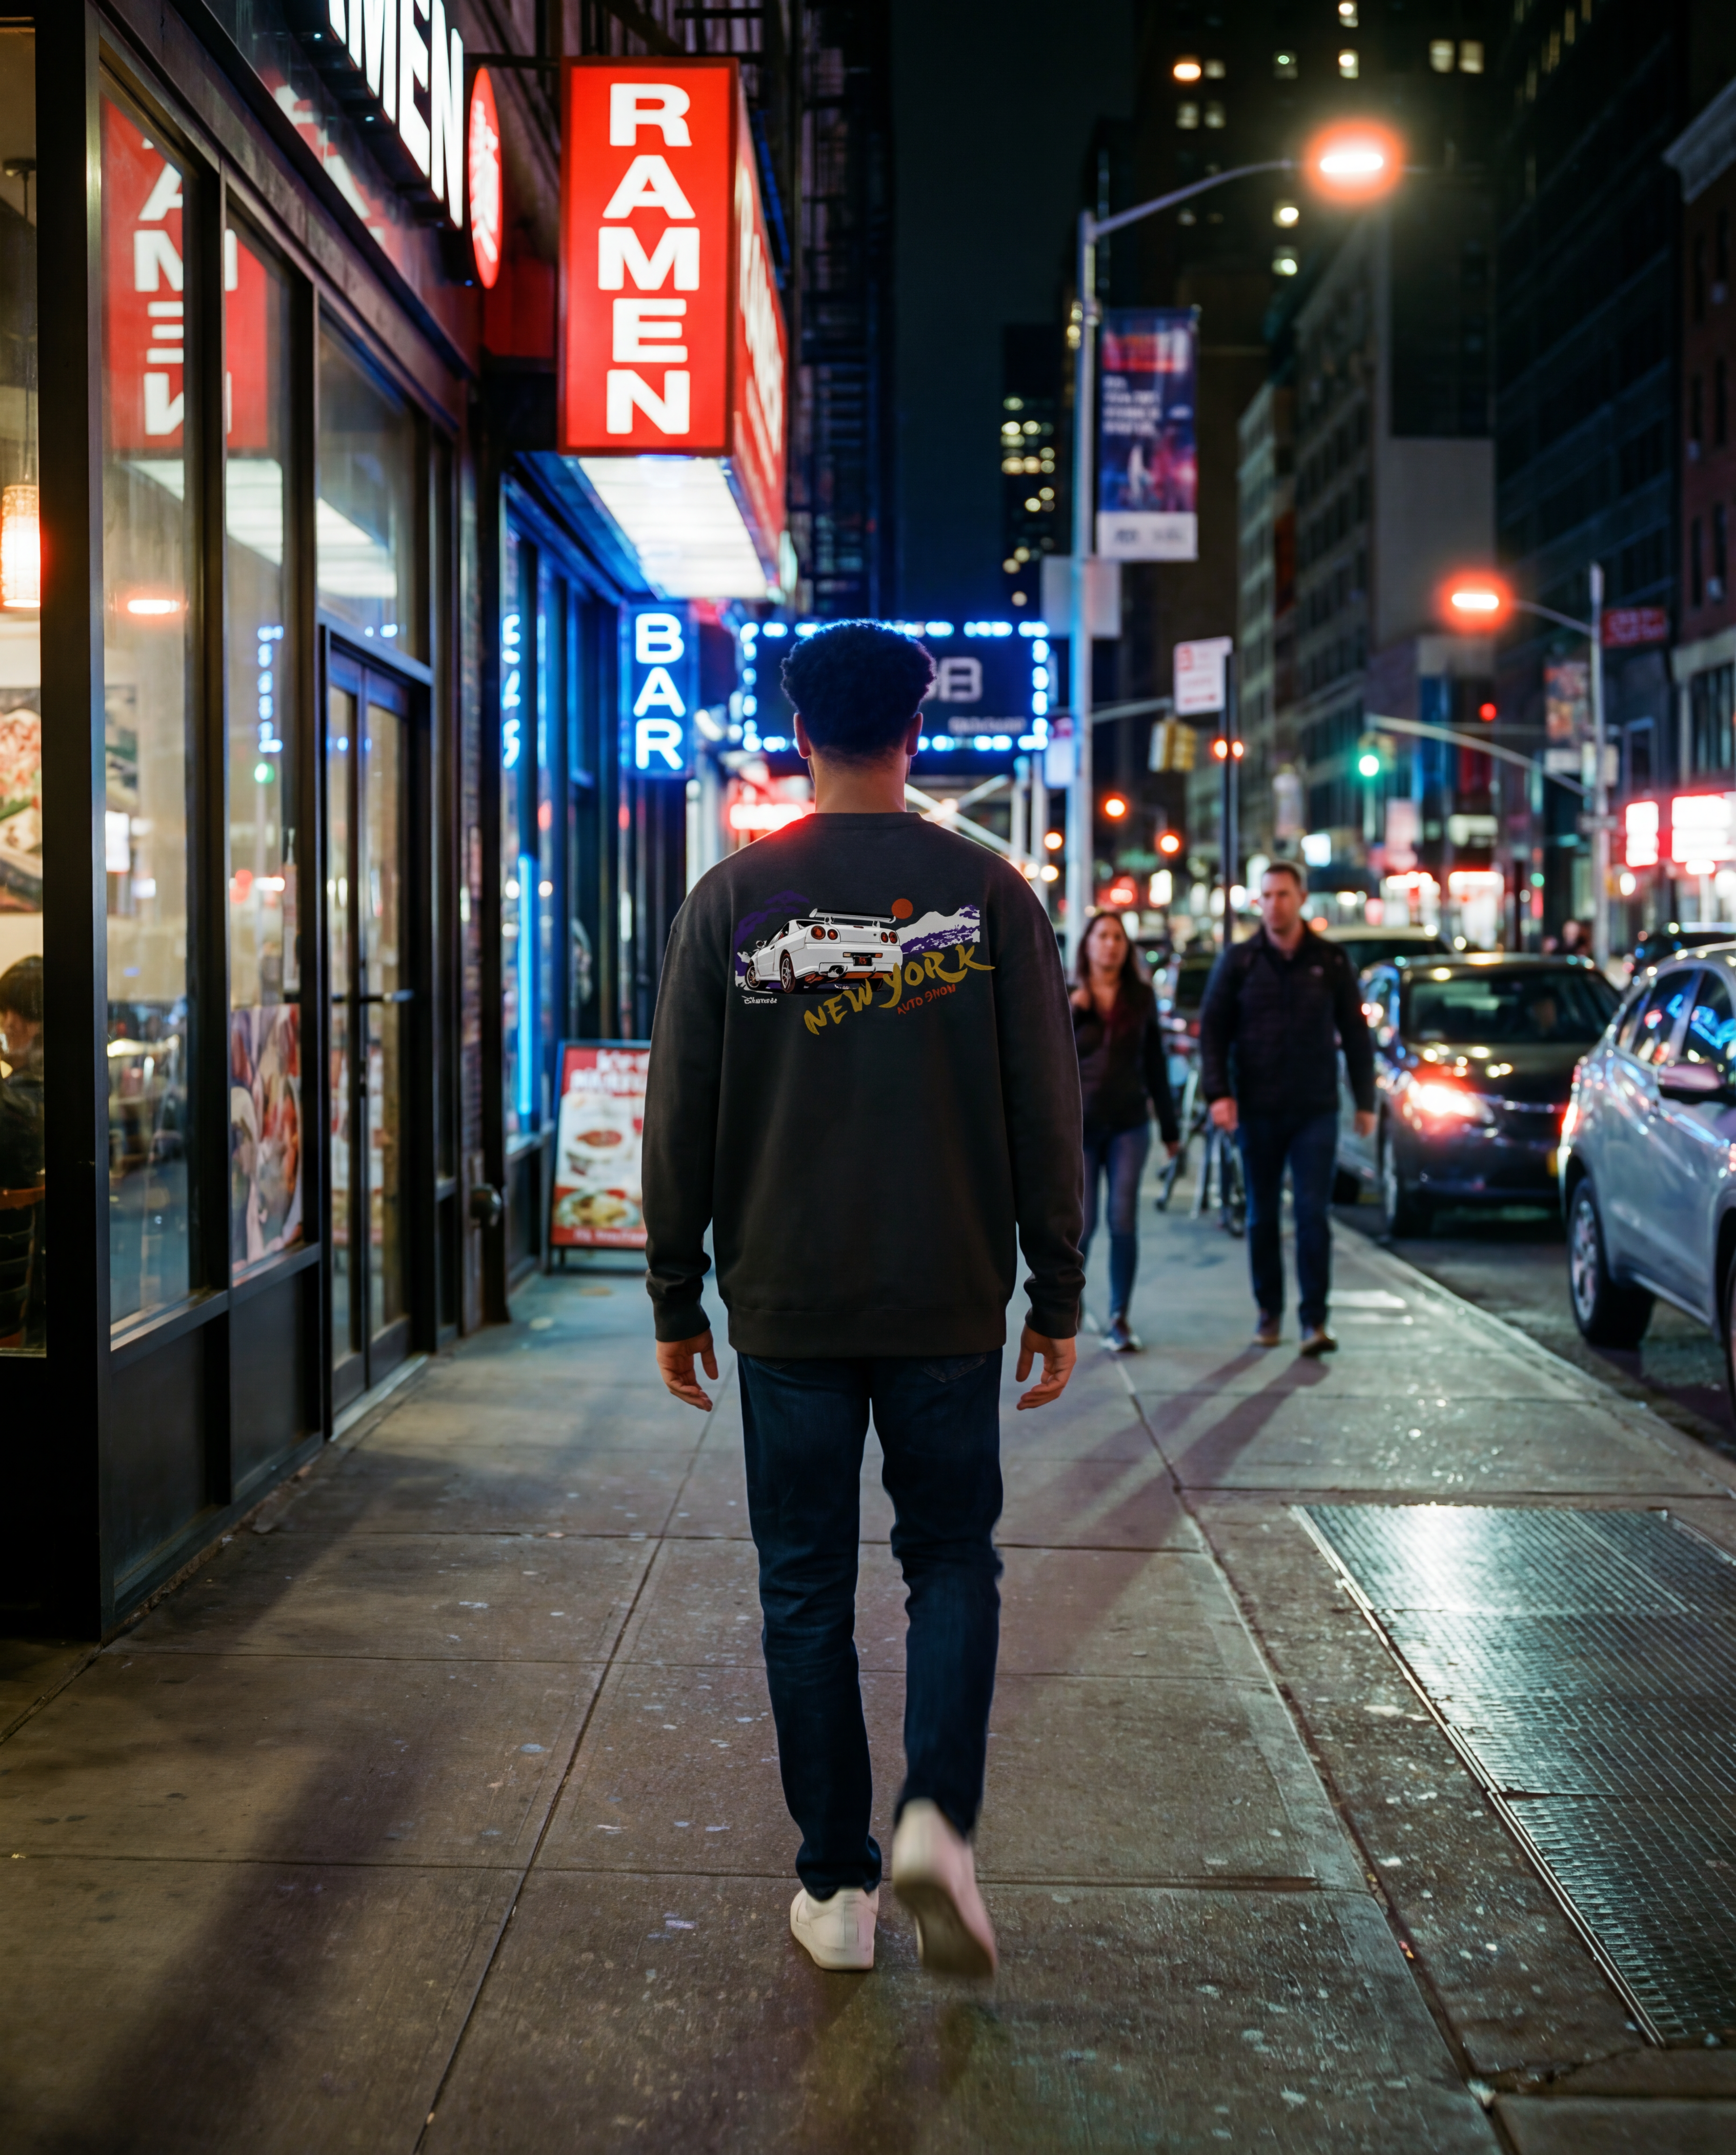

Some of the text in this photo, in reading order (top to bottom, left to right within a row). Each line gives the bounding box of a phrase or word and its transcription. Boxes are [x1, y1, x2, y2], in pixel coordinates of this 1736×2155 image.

[328, 0, 464, 230] MEN
[598, 83, 701, 435] RAMEN
[633, 612, 686, 771] BAR
[803, 944, 996, 1035] NEW YORK
[897, 997, 924, 1015] AUTO
